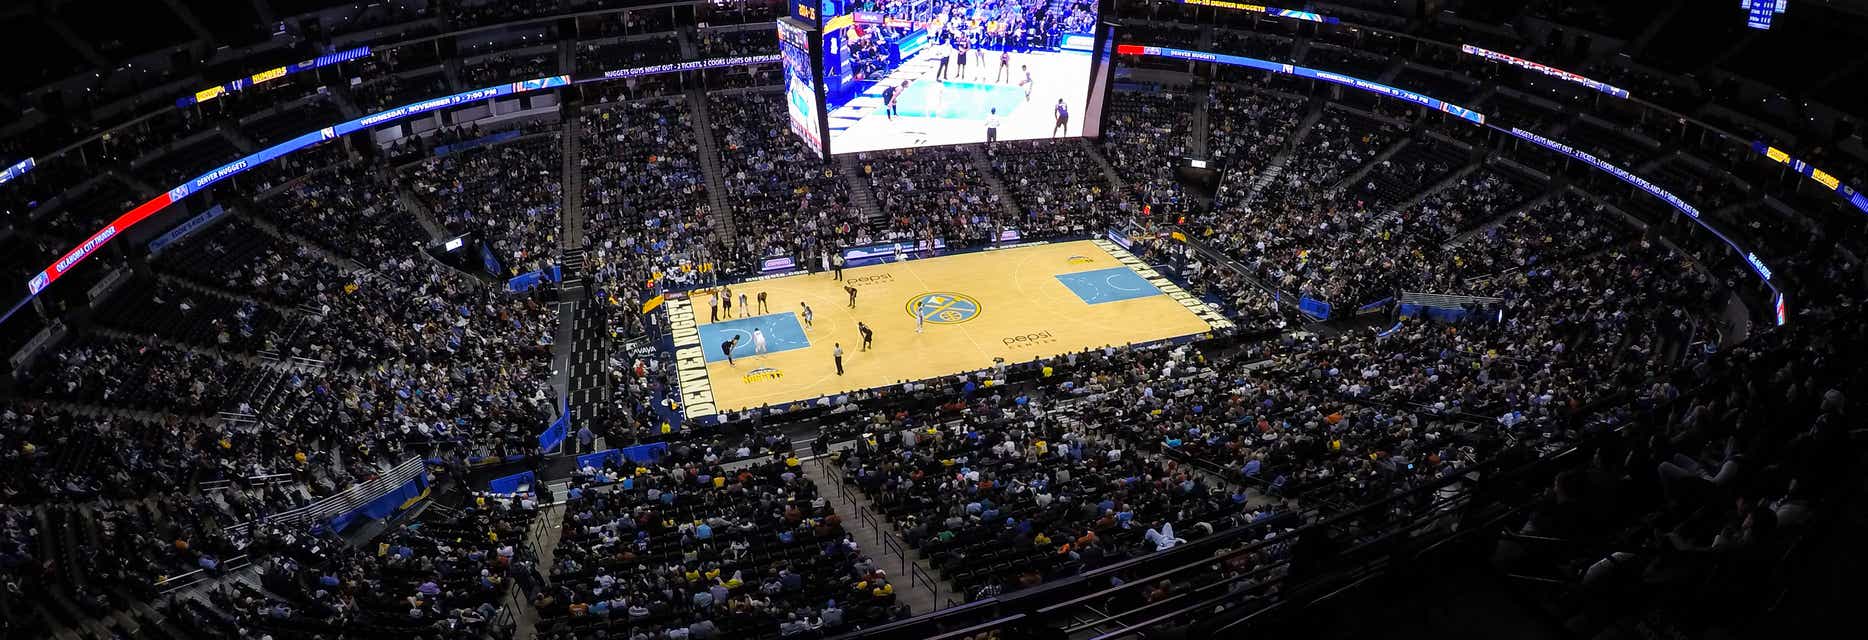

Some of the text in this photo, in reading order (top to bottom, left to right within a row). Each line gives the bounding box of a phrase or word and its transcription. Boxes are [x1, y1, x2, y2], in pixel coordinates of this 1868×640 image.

[1210, 1, 1236, 9] DENVER
[1236, 3, 1266, 12] NUGGETS
[1170, 50, 1190, 58] DENVER
[252, 66, 287, 85] NUMBERS
[604, 68, 629, 79] NUGGETS
[630, 66, 644, 75] GUYS
[645, 64, 661, 74] NIGHT
[662, 63, 673, 71] OUT
[726, 56, 744, 65] LIGHTS
[1316, 71, 1356, 86] WEDNESDAY,
[1356, 81, 1391, 94] NOVEMBER
[1418, 95, 1429, 104] PM
[360, 108, 408, 126] WEDNESDAY,
[408, 99, 450, 113] NOVEMBER
[451, 96, 461, 104] 19
[484, 88, 497, 97] PM
[1511, 127, 1534, 140] NUGGETS
[1546, 138, 1562, 150] NIGHT
[1561, 145, 1573, 154] OUT
[196, 160, 247, 187] DENVER NUGGETS
[56, 225, 116, 273] OKLAHOMA CITY THUNDER
[847, 272, 892, 285] pepsi
[633, 345, 657, 355] AVAYA
[1002, 330, 1052, 347] pepsi
[676, 346, 717, 419] DENVER
